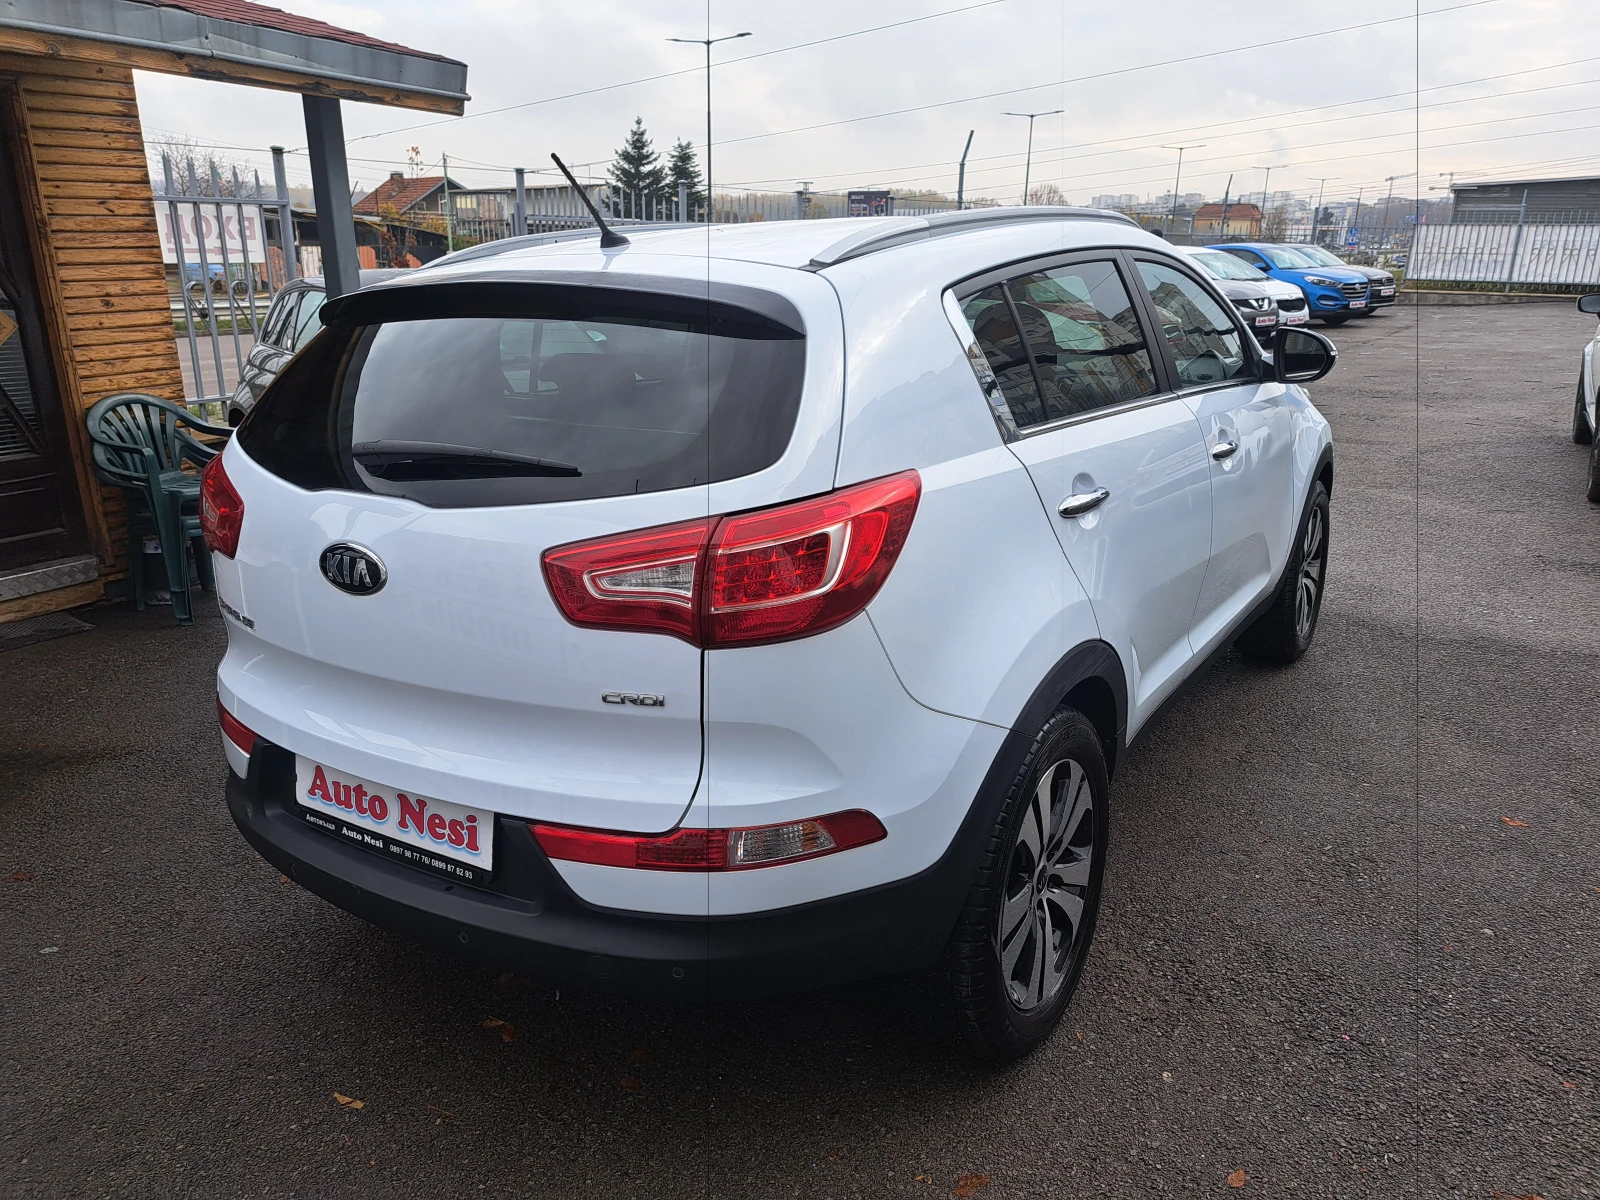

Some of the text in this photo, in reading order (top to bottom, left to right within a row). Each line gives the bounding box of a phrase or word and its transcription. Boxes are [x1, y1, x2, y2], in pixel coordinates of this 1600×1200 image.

[325, 552, 372, 587] KIA
[306, 813, 335, 830] Автокъща
[307, 765, 481, 852] Auto Nesi
[342, 826, 383, 848] Auto Nesi
[413, 852, 420, 861] 77
[431, 859, 446, 871] 0899
[465, 869, 473, 880] 93
